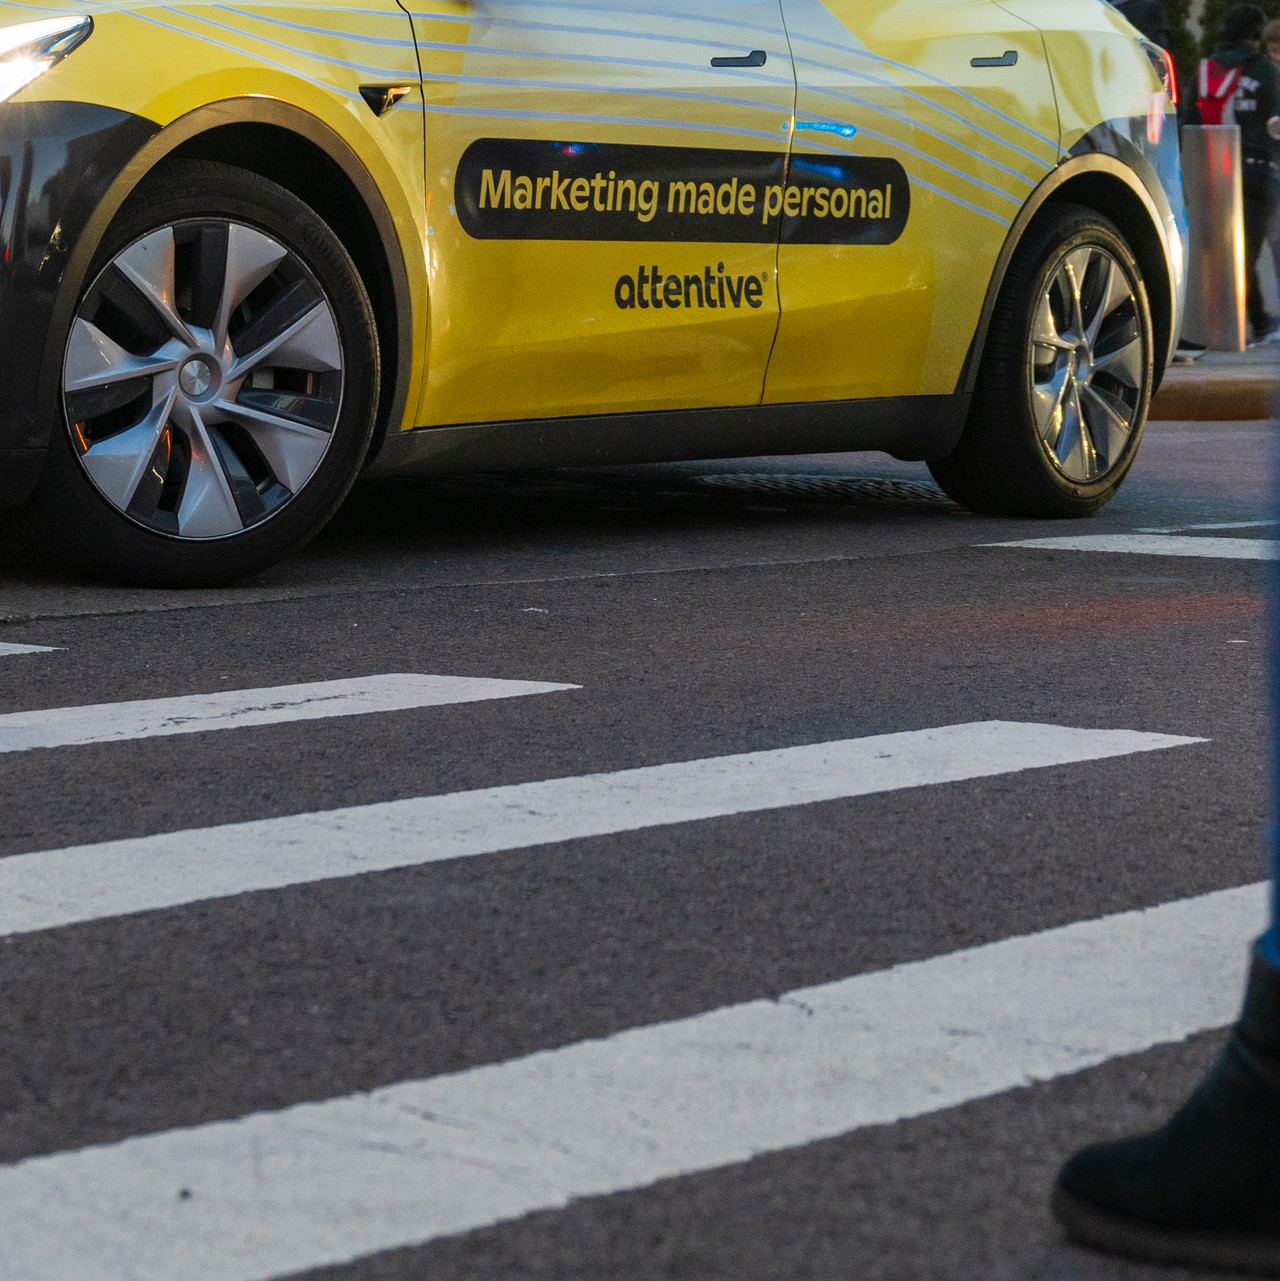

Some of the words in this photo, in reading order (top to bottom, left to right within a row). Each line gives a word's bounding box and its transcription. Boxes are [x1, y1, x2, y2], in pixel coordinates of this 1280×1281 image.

[479, 169, 660, 222] Marketing
[667, 176, 756, 216] made
[761, 183, 892, 225] personal
